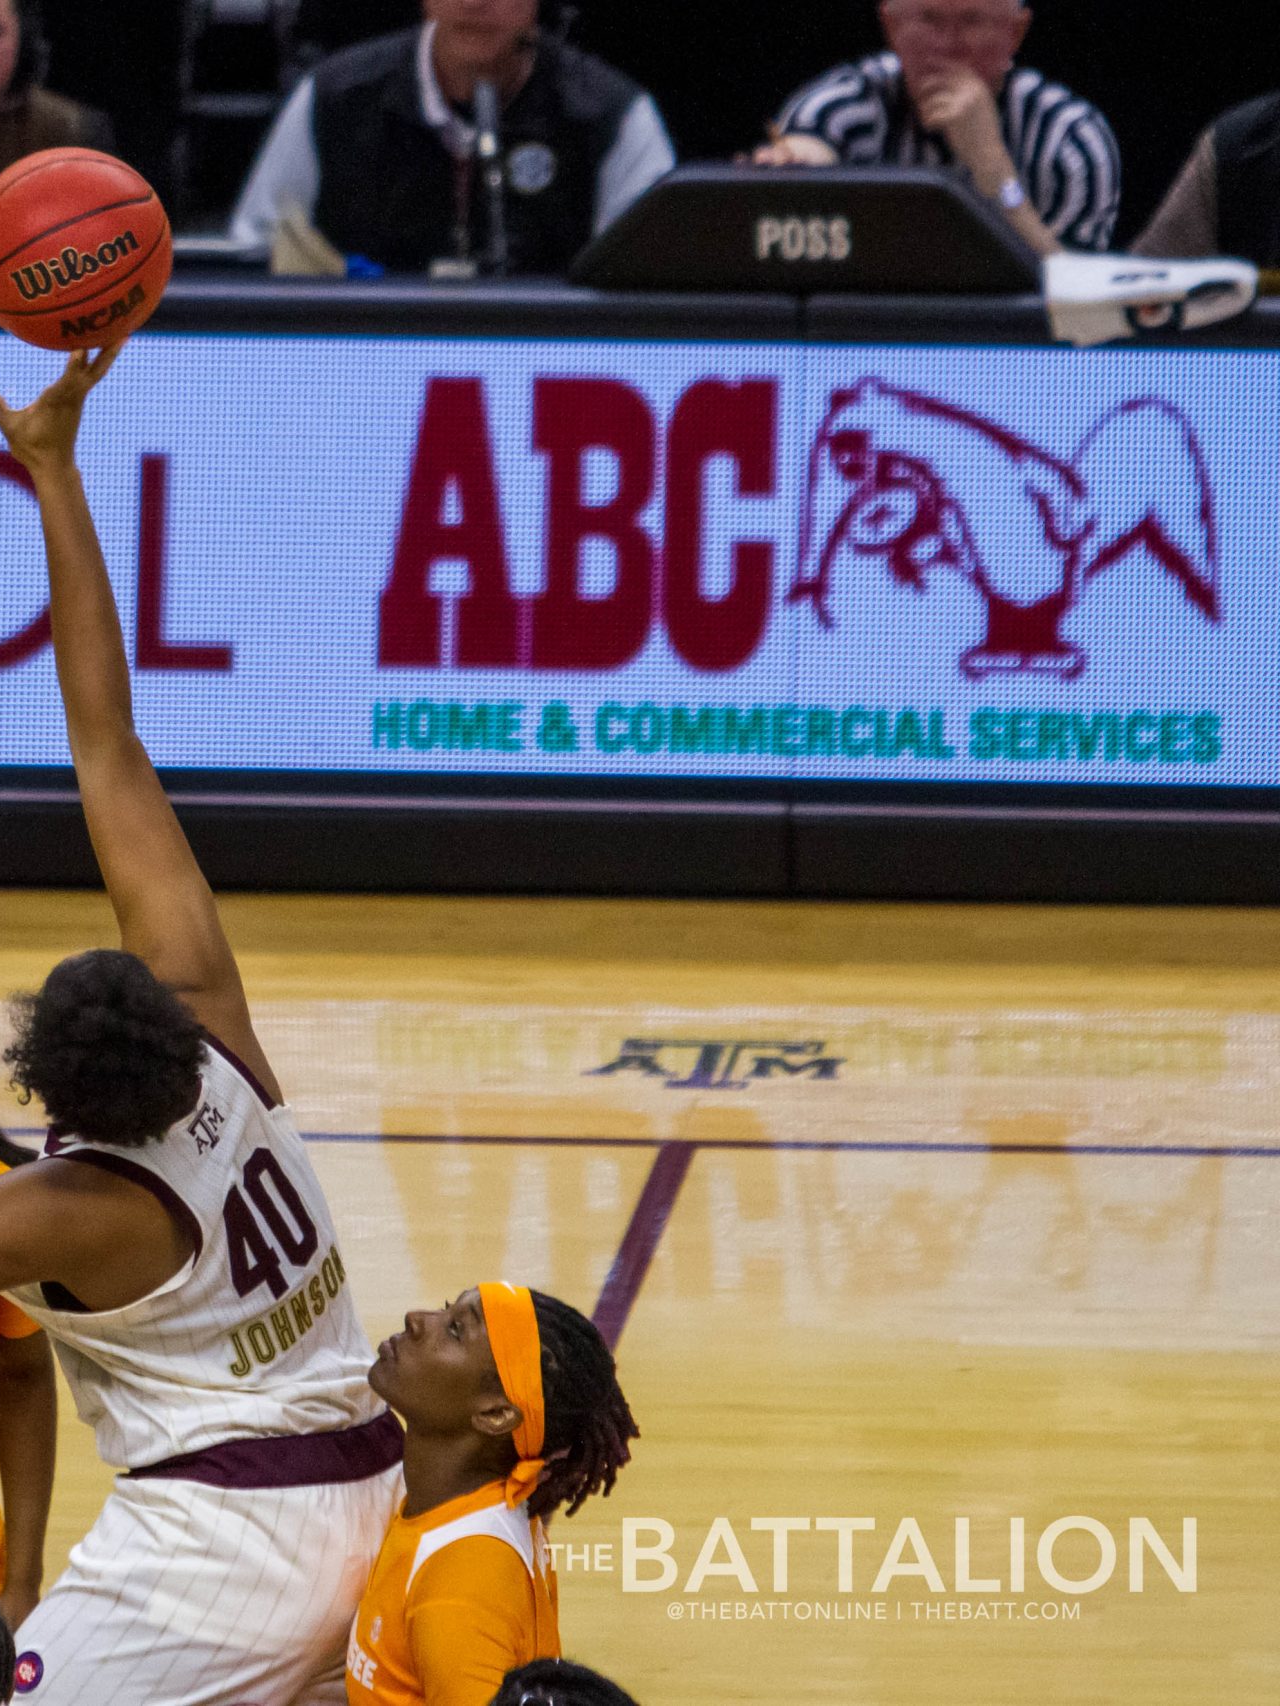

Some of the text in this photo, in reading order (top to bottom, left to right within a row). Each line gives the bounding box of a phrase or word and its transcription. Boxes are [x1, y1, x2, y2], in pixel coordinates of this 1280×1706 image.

[10, 230, 140, 300] Wilson
[756, 216, 851, 261] POSS
[376, 374, 780, 672] ABC
[371, 700, 1221, 764] HOME & COMMERCIAL SERVICES
[222, 1146, 319, 1301] 40
